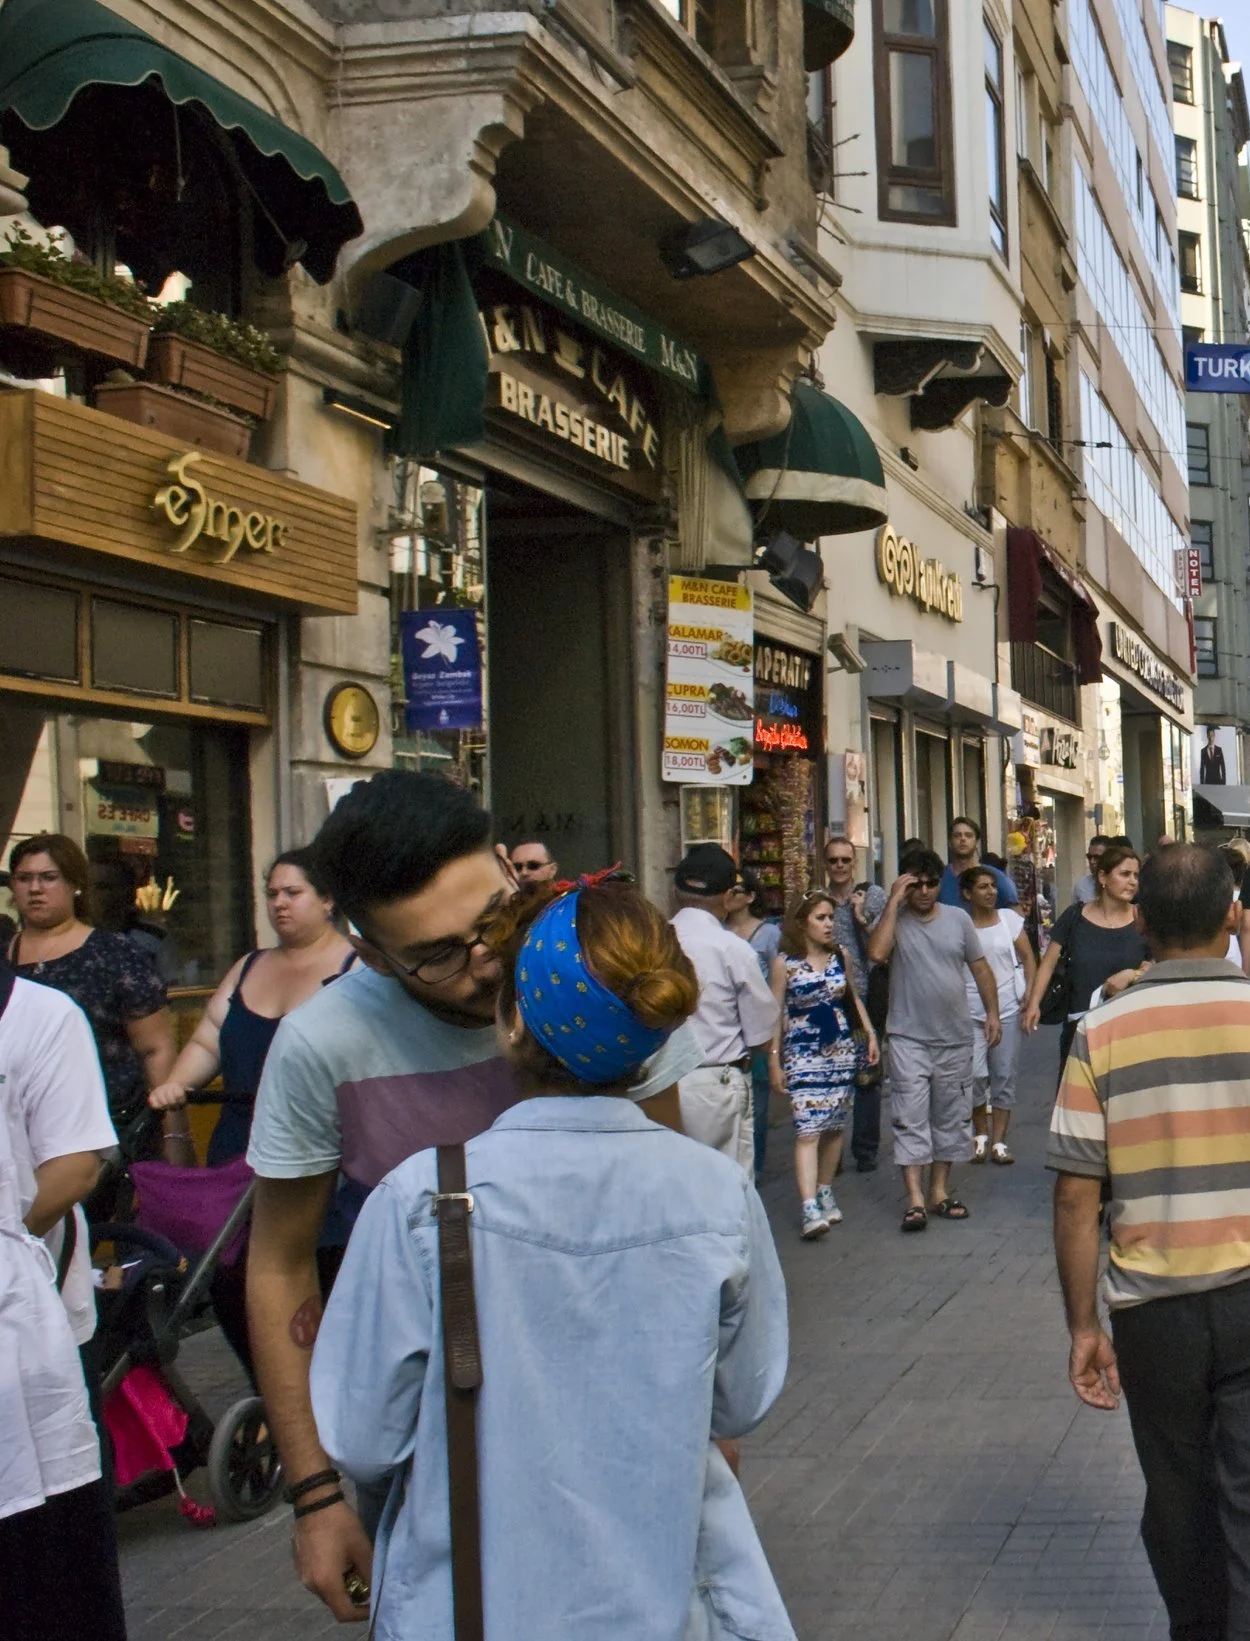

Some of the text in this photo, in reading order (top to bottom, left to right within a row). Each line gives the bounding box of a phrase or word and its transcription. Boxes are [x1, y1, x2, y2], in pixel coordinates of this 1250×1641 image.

[526, 252, 565, 300] CAFE
[566, 279, 579, 310] &
[581, 289, 646, 353] BRASSERIE
[501, 372, 629, 471] BRASSERIE
[1189, 550, 1200, 596] NOTER
[681, 580, 738, 597] M&N CAFE
[682, 593, 737, 609] BRASSERIE
[666, 702, 706, 715] 16,00TL
[665, 737, 709, 751] SOMON
[665, 755, 706, 767] 18,00TL
